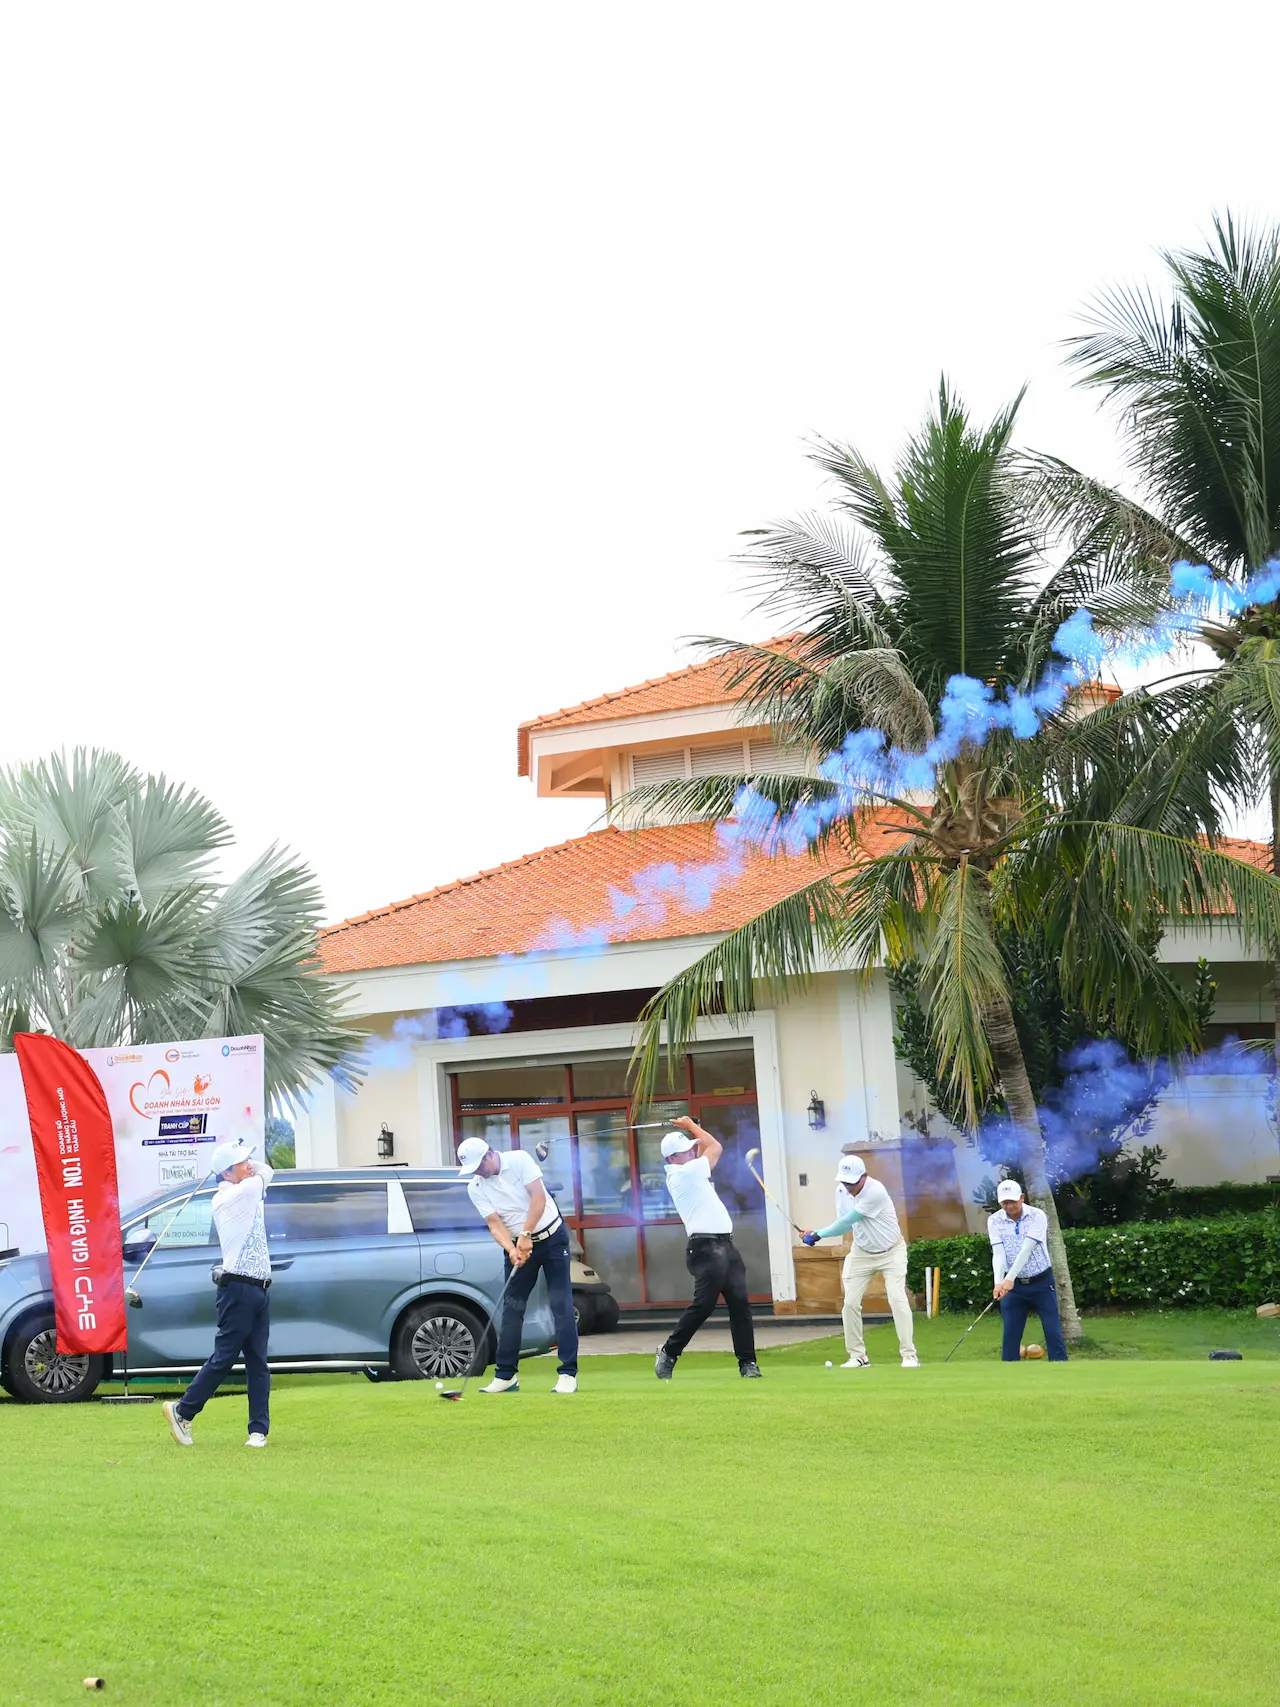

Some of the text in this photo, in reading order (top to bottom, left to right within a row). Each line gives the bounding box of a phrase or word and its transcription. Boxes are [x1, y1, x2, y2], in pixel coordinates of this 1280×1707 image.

[144, 1101, 169, 1109] DOANH
[57, 1130, 66, 1155] DOANH
[66, 1145, 72, 1153] XE
[61, 1157, 83, 1188] NO.1
[67, 1198, 90, 1236] ĐỊNH
[71, 1237, 89, 1263] GIA
